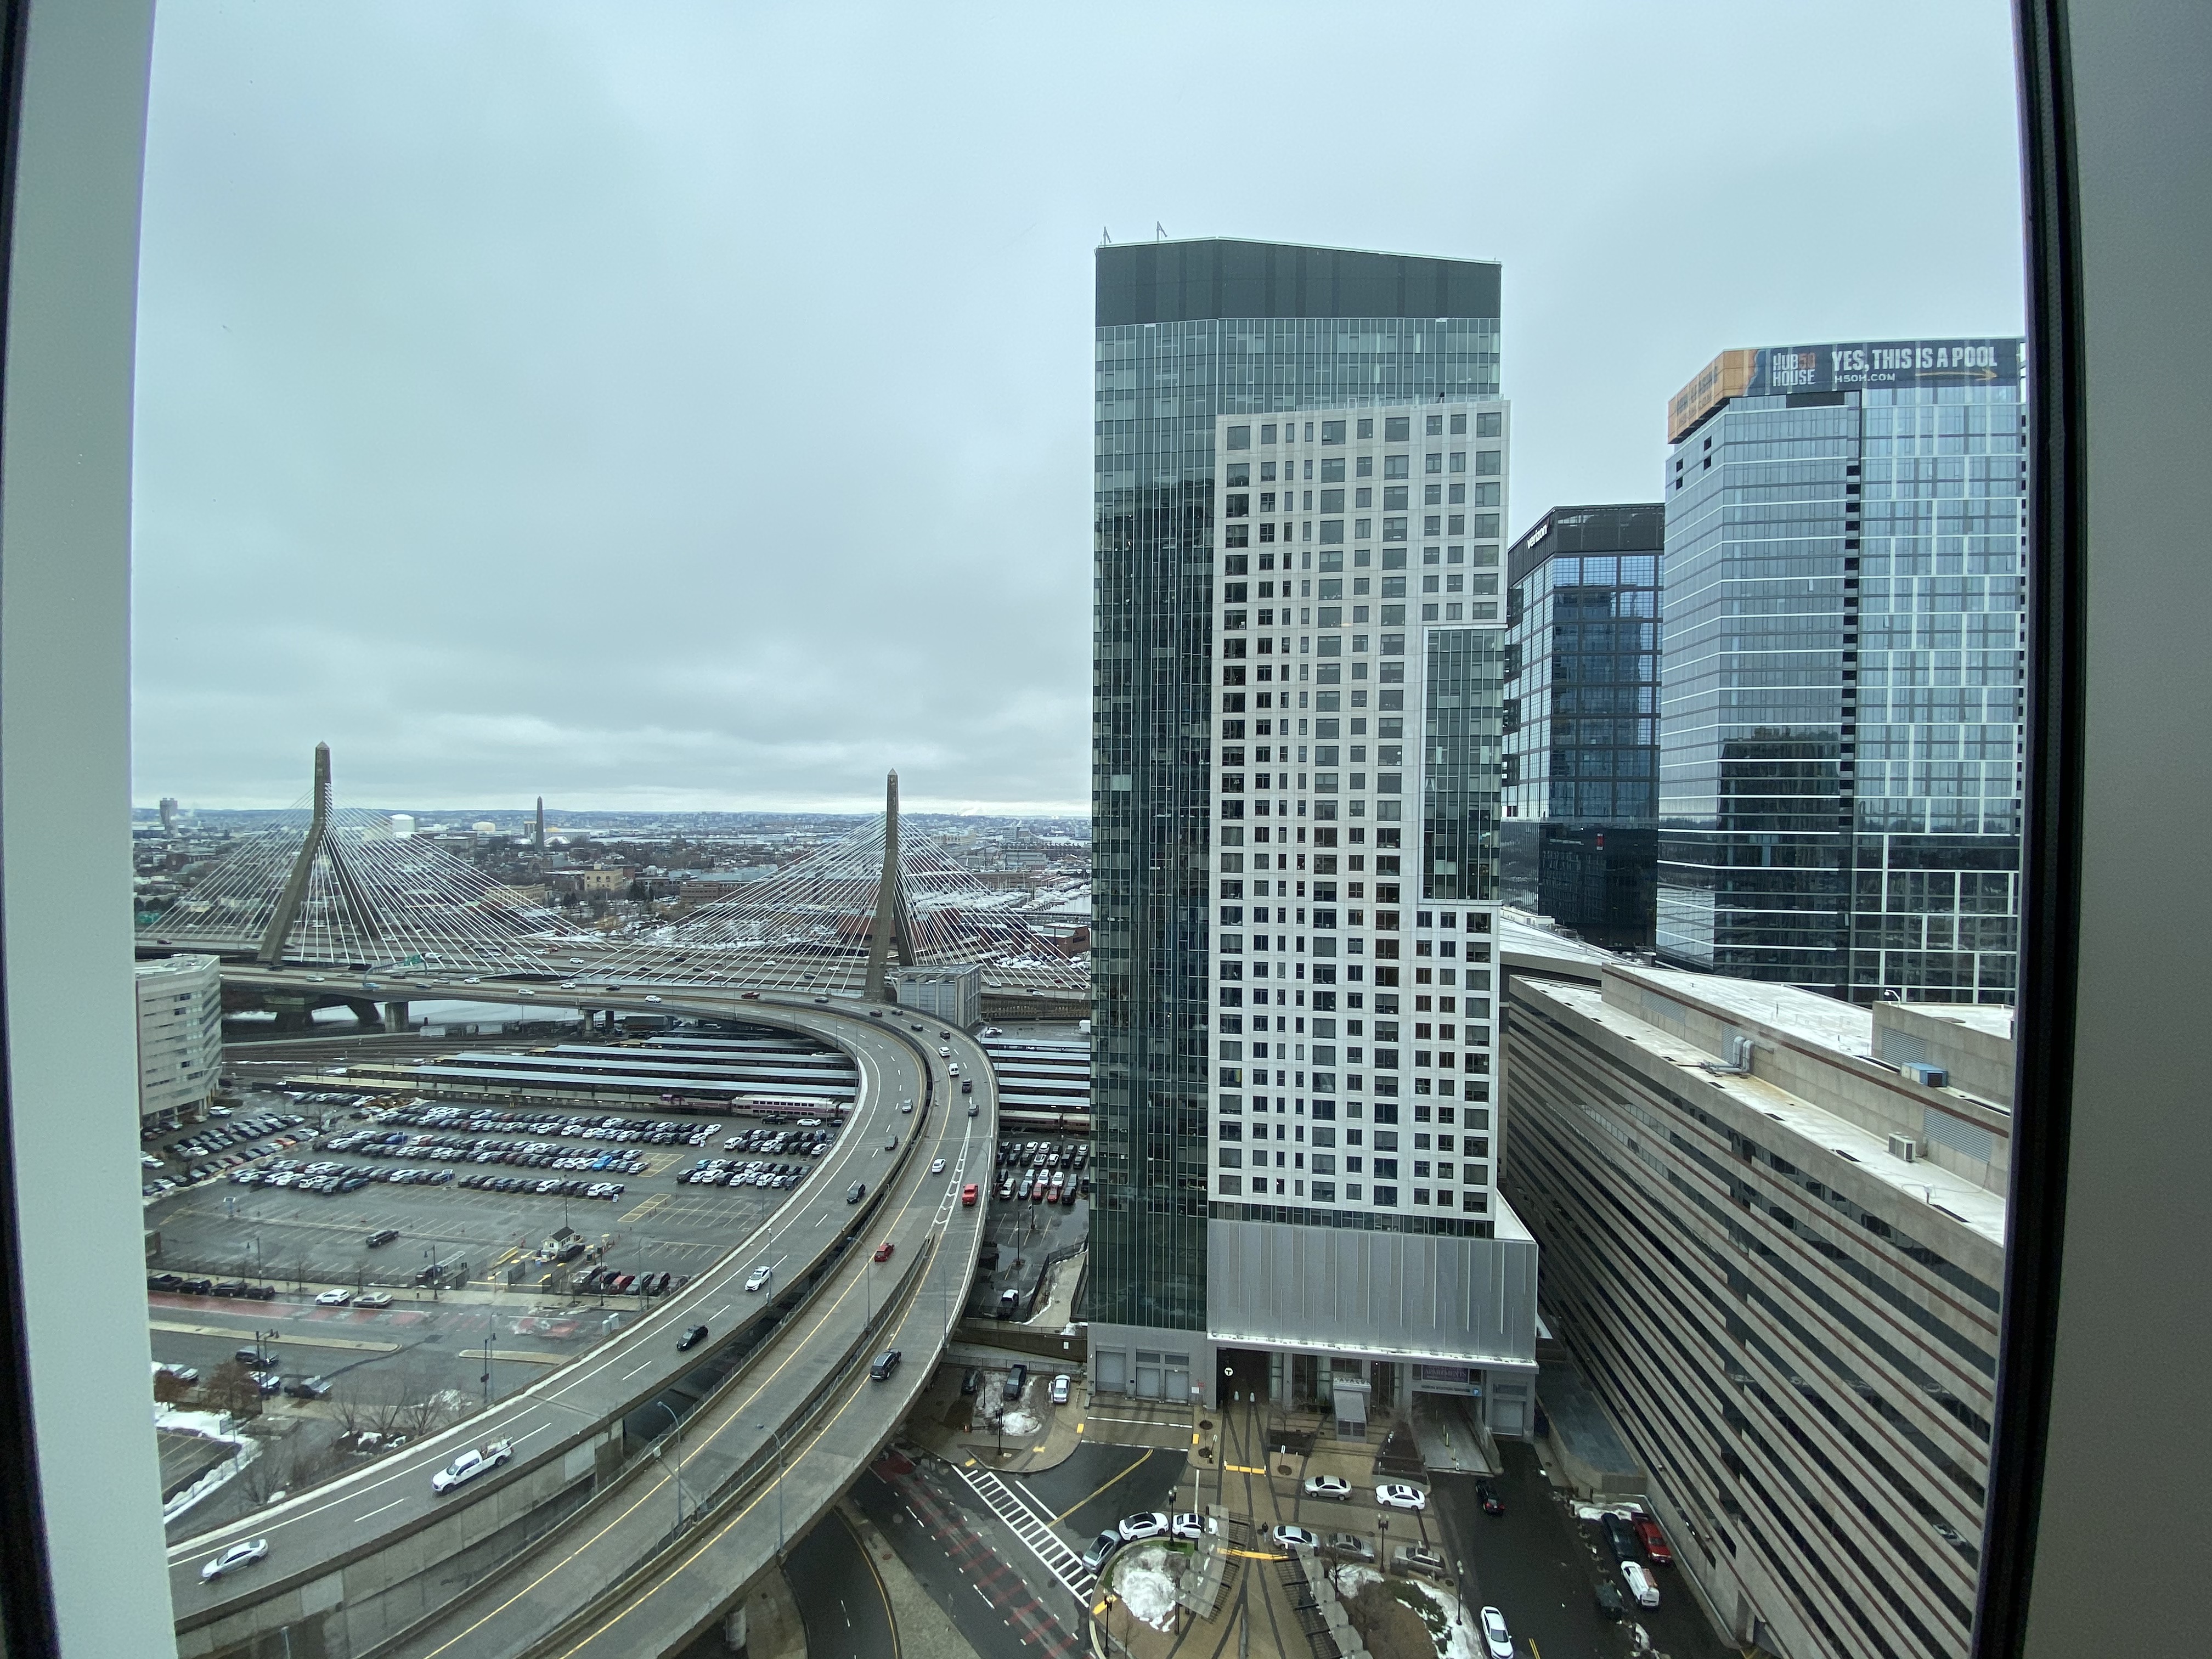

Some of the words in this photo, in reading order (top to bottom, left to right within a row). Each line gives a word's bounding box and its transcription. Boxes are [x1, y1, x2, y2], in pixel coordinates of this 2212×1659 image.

[1832, 349, 1870, 372] YES,
[1872, 348, 1912, 370] THIS
[1915, 347, 1933, 369] IS
[1937, 347, 1949, 368] A
[1952, 346, 1997, 368] POOL
[1773, 369, 1816, 387] HOUSE
[1527, 524, 1548, 549] verizon
